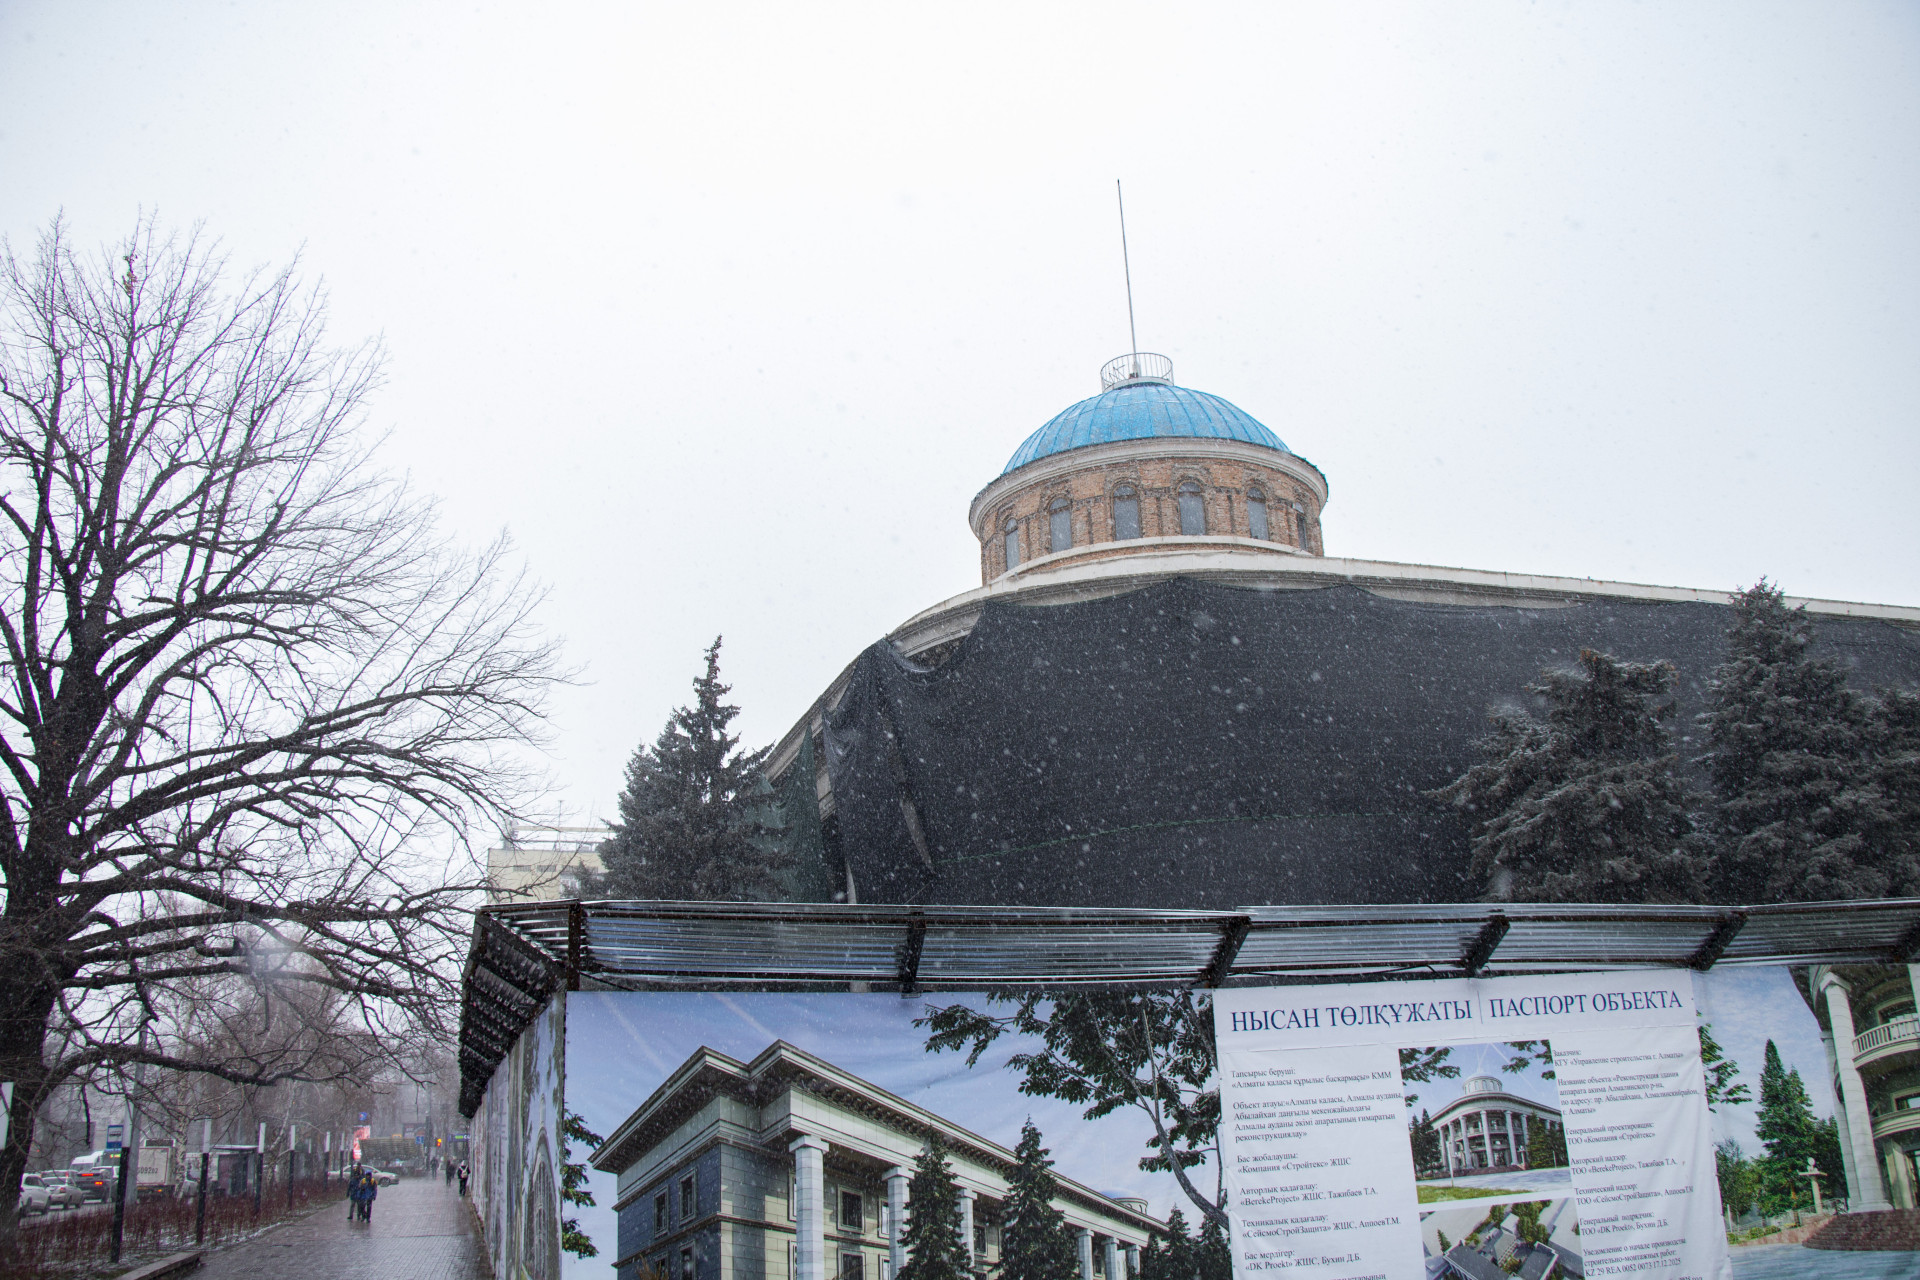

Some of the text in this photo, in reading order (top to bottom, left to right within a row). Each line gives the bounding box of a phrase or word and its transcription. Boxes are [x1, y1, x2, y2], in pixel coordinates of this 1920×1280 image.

[1231, 999, 1472, 1032] НЫСАН ТӨЛҚҰЖАТЫ
[1489, 989, 1682, 1017] ПАСПОРТ ОБЪЕКТА
[1585, 1268, 1595, 1276] KZ
